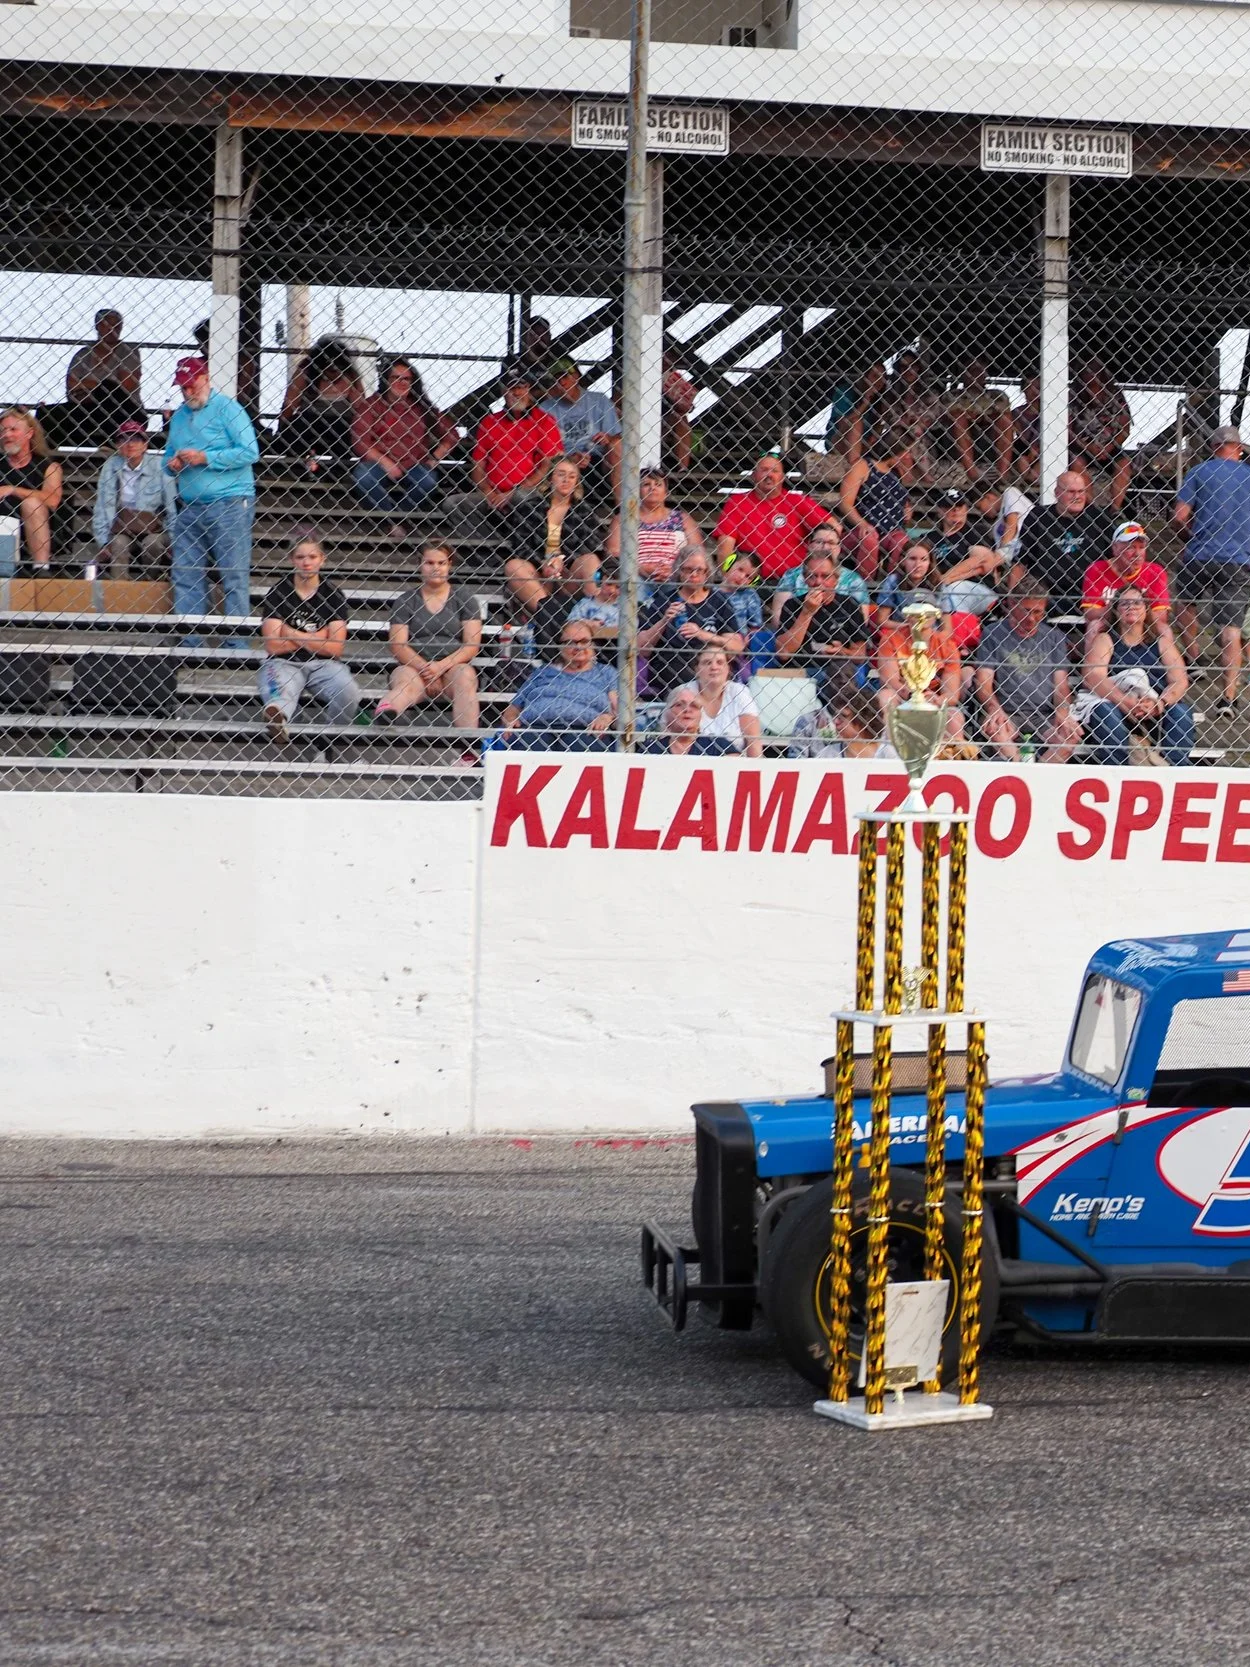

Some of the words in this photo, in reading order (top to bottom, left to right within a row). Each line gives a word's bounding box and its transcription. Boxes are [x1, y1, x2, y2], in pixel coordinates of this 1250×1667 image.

[578, 105, 630, 127] FAMIL
[647, 109, 724, 131] SECTION
[578, 127, 594, 140] NO
[596, 128, 632, 141] SMOK
[657, 131, 672, 143] NO
[674, 132, 723, 146] ALCOHOL
[987, 130, 1049, 151] FAMILY
[1052, 132, 1127, 154] SECTION
[987, 151, 1001, 162] NO
[1004, 152, 1055, 165] SMOKING
[1063, 154, 1077, 166] NO
[1079, 155, 1126, 168] ALCOHOL
[1052, 1192, 1145, 1214] Kemp's
